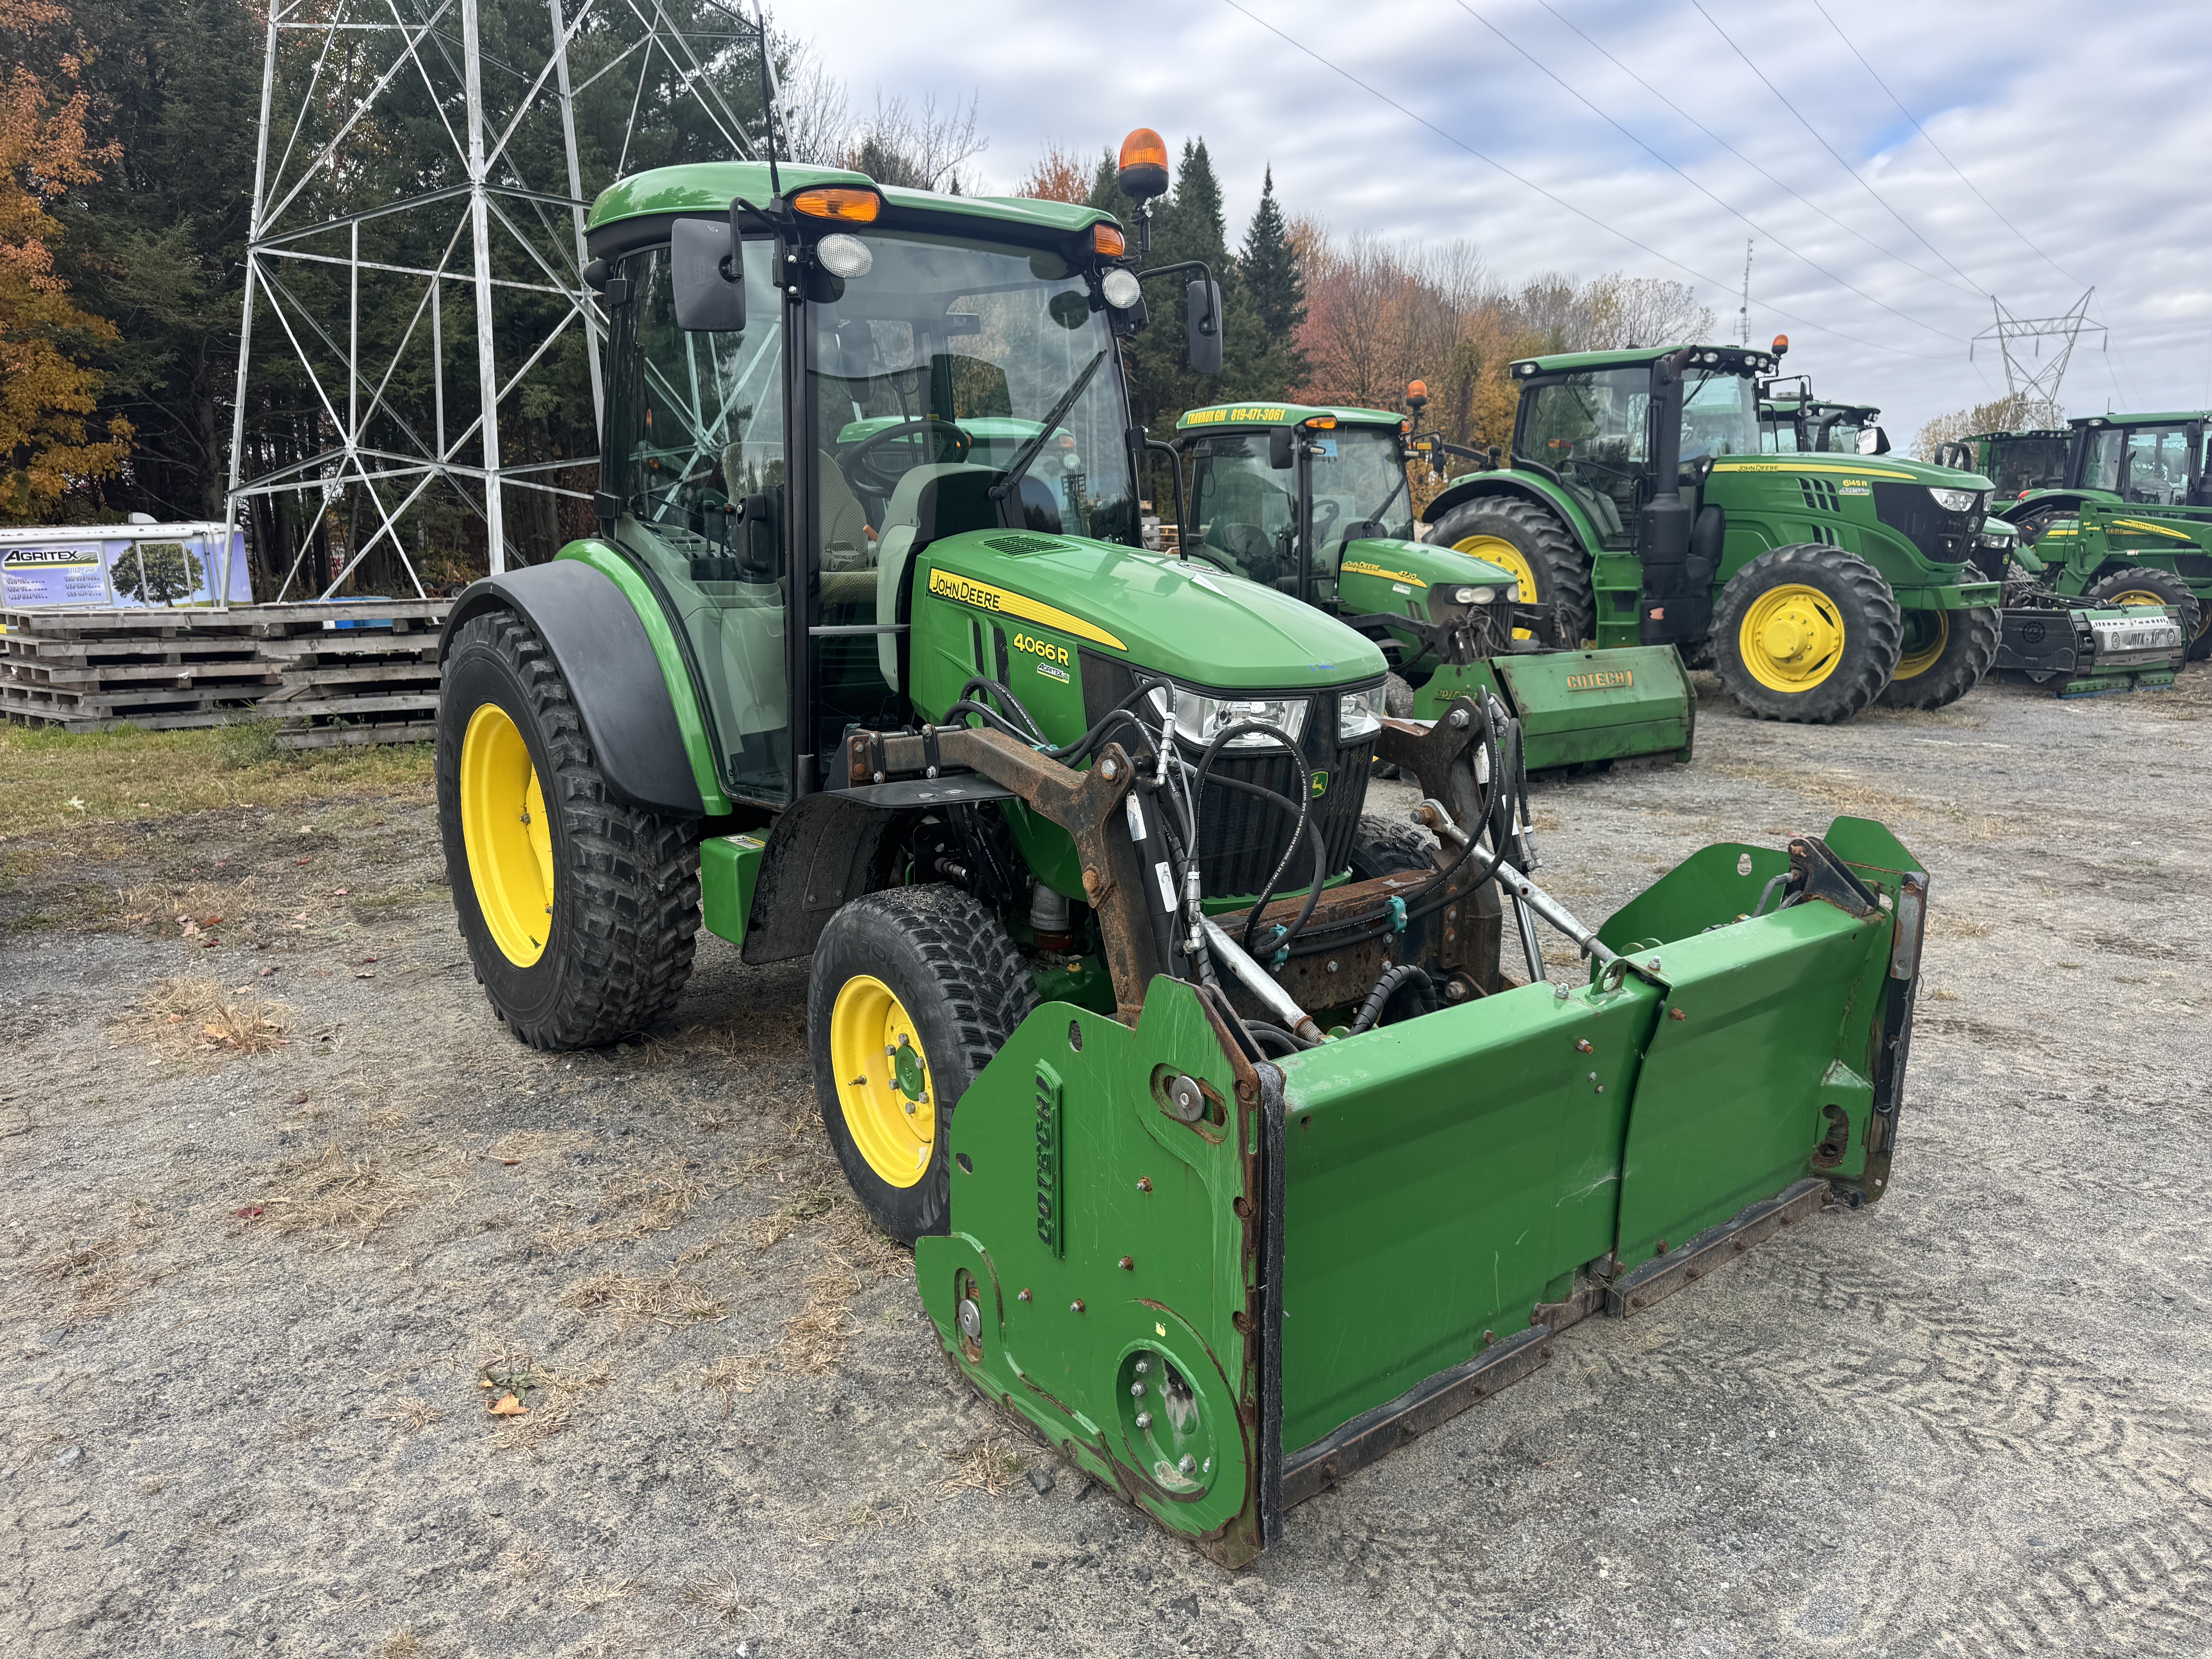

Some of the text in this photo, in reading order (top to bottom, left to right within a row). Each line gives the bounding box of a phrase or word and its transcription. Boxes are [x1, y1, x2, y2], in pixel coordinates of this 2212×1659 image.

[1187, 409, 1286, 424] TRAVAUX GM 819-471-3061
[4, 550, 78, 562] AGRITEX
[1358, 562, 1381, 571] DEERE
[933, 575, 1001, 610] JOHN DEERE
[1039, 663, 1063, 677] AGRITEX
